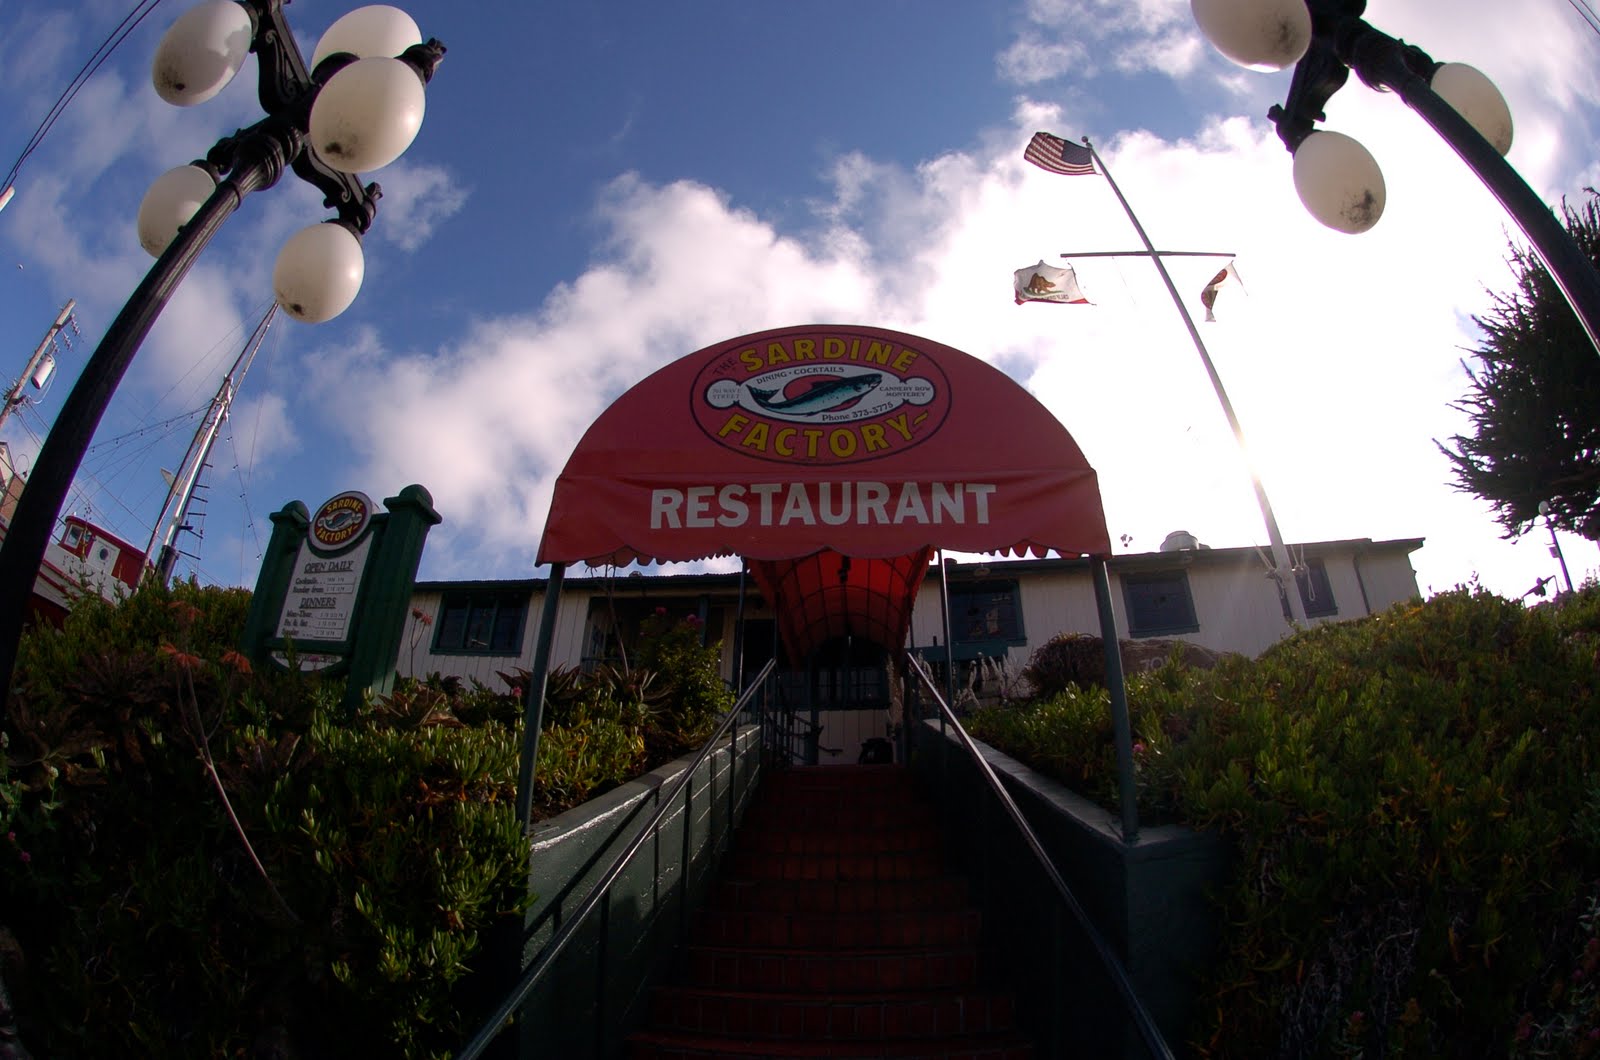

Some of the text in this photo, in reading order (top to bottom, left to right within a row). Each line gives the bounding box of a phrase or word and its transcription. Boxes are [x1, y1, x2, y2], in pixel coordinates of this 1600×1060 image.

[738, 337, 920, 373] SARDINE
[756, 366, 845, 385] DINING COCKTAILS
[821, 413, 850, 422] Phone
[326, 498, 364, 513] SARDINE
[650, 481, 997, 530] RESTAURANT
[304, 560, 354, 572] OPEN DAILY
[300, 597, 338, 607] DINNERS
